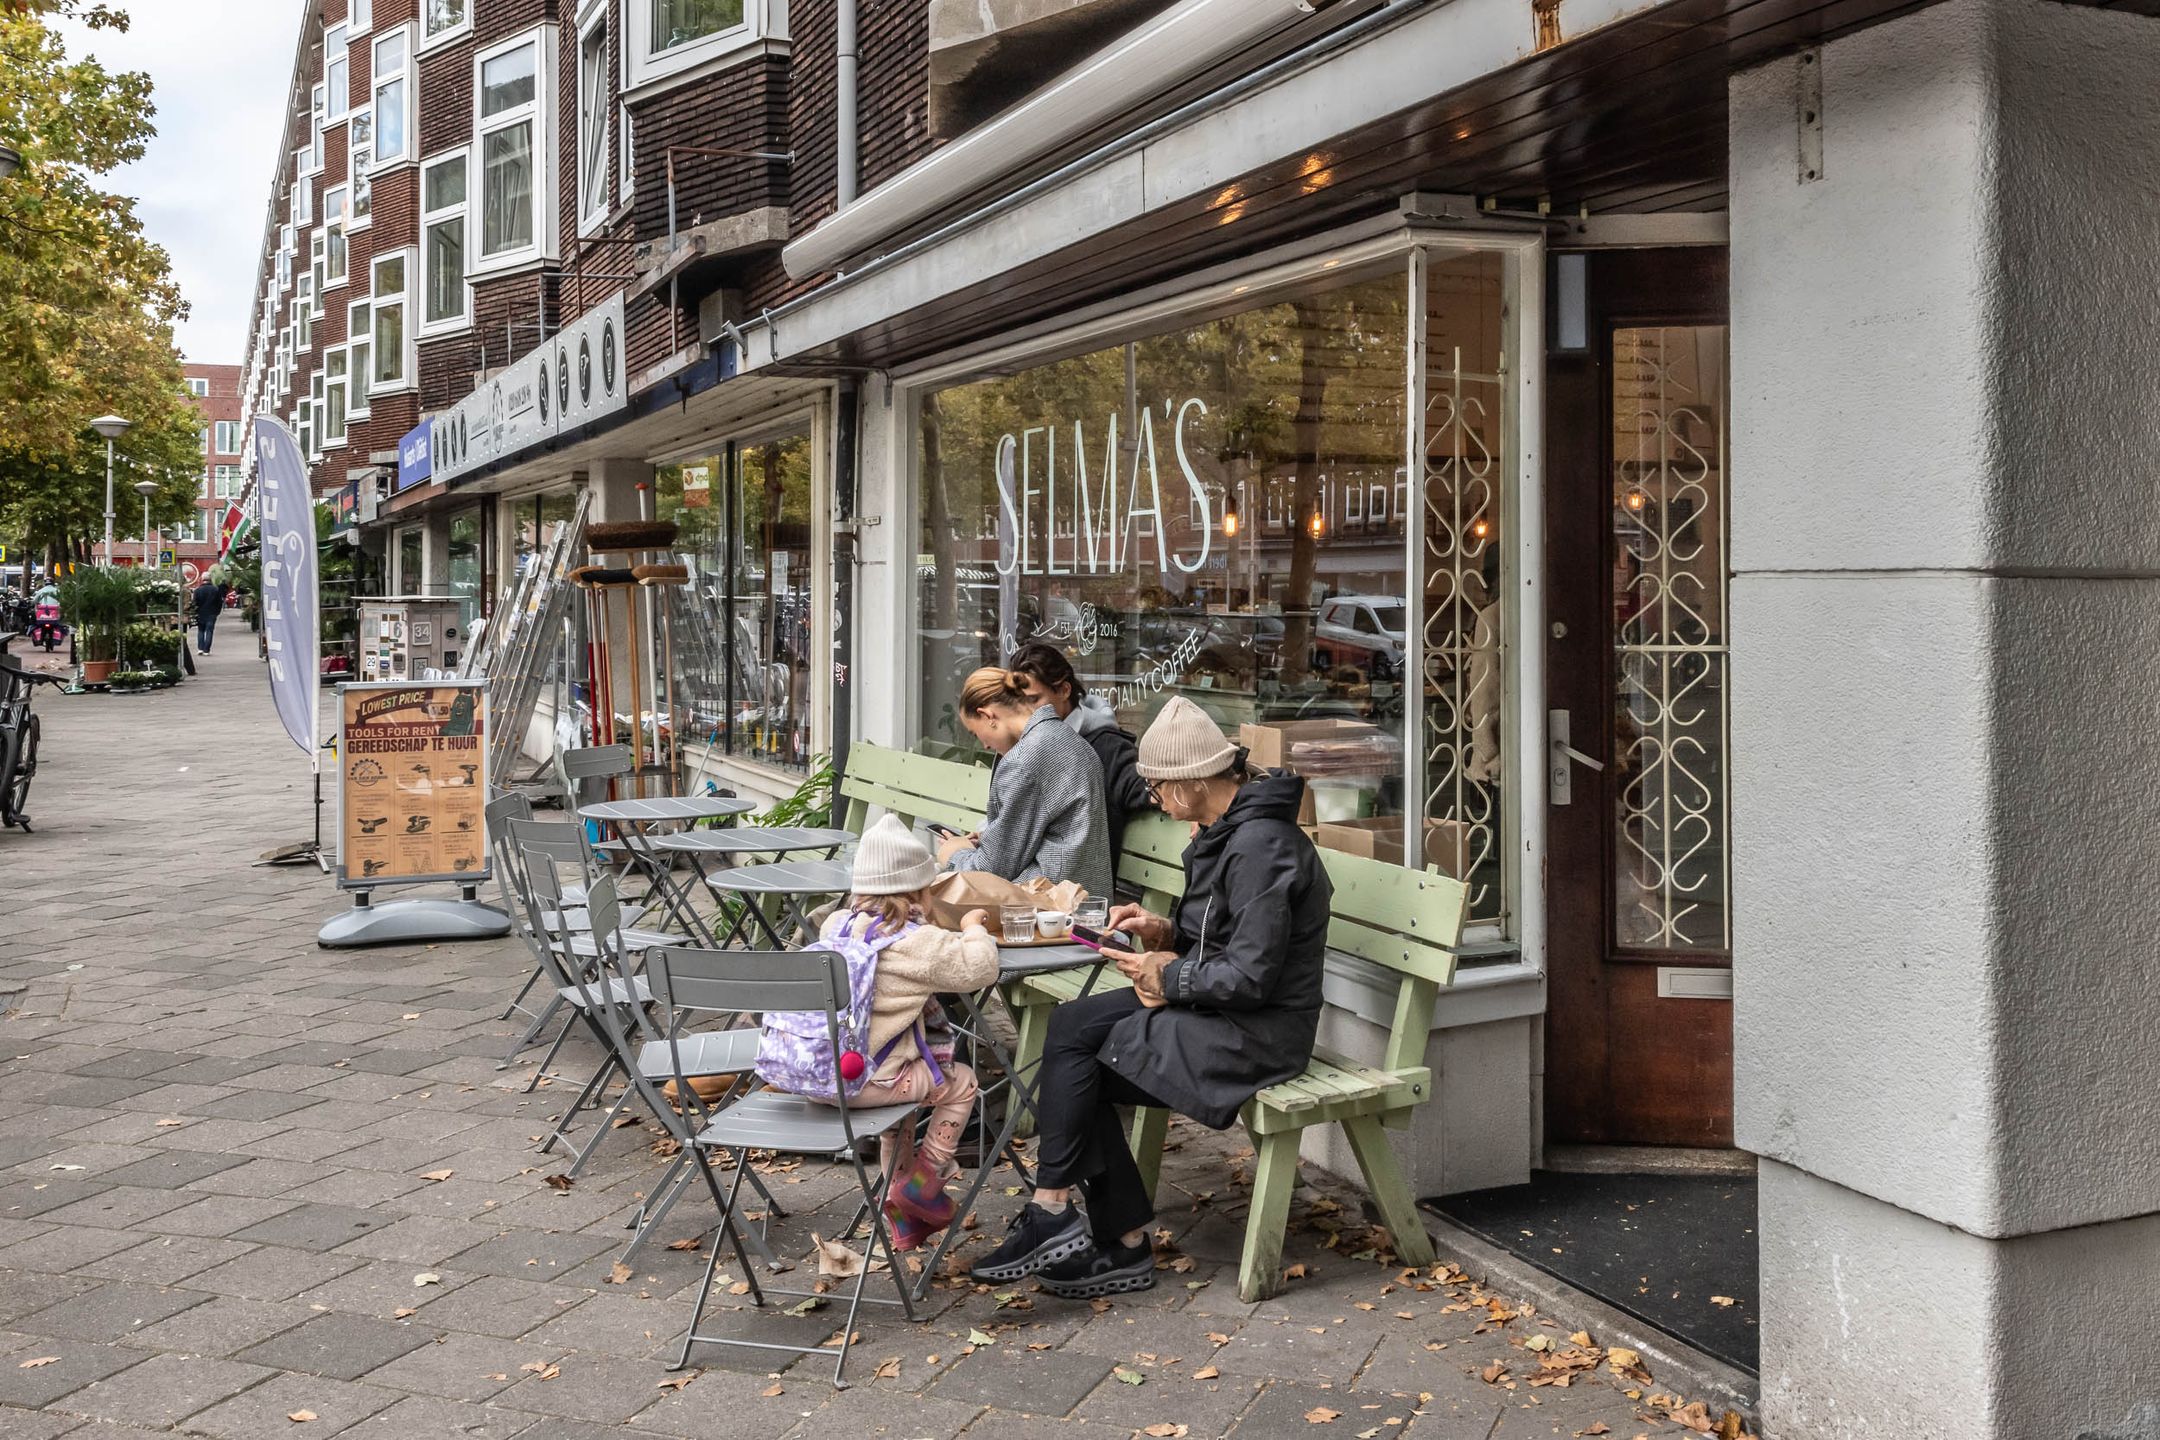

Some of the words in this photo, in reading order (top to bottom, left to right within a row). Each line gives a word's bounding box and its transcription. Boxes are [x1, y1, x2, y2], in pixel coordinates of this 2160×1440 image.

[993, 397, 1211, 576] SELMA'S
[414, 625, 430, 638] 34
[1100, 623, 1118, 637] 2016
[367, 657, 376, 667] 29
[1151, 627, 1202, 693] COFFEE
[361, 695, 397, 716] LOWEST
[398, 690, 426, 705] PRICE
[349, 728, 384, 738] TOOLS
[387, 727, 409, 737] FOR
[412, 725, 441, 736] RENT
[347, 738, 428, 754] GEREEDSCHAP
[431, 737, 444, 751] TE
[448, 736, 478, 750] HUUR
